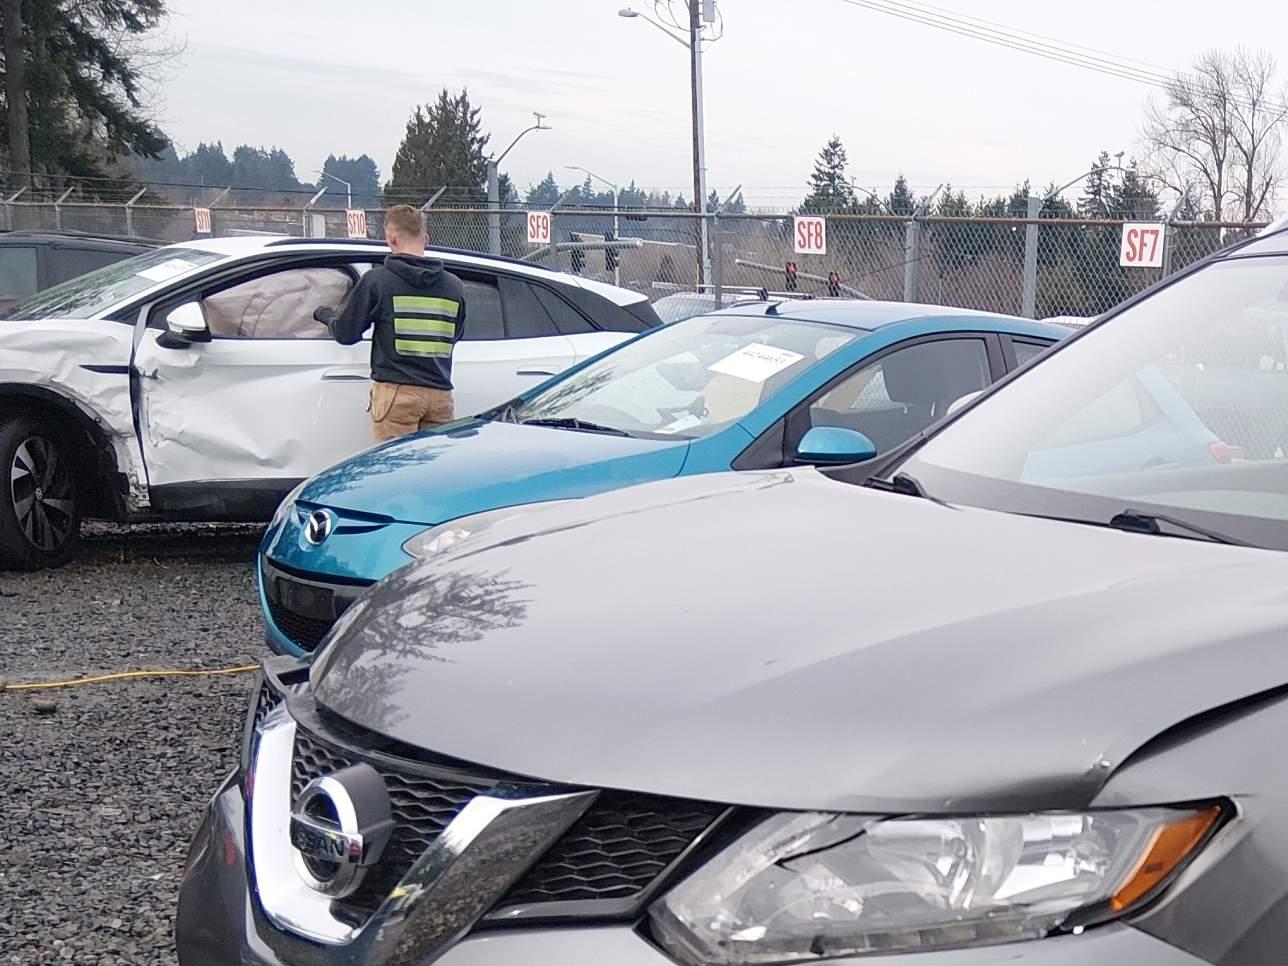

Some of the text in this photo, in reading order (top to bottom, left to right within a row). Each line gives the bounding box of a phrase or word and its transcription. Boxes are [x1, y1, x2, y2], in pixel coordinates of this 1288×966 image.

[348, 213, 364, 234] SF10
[529, 214, 549, 239] SF9
[797, 220, 823, 249] SF8
[1126, 228, 1160, 262] SF7
